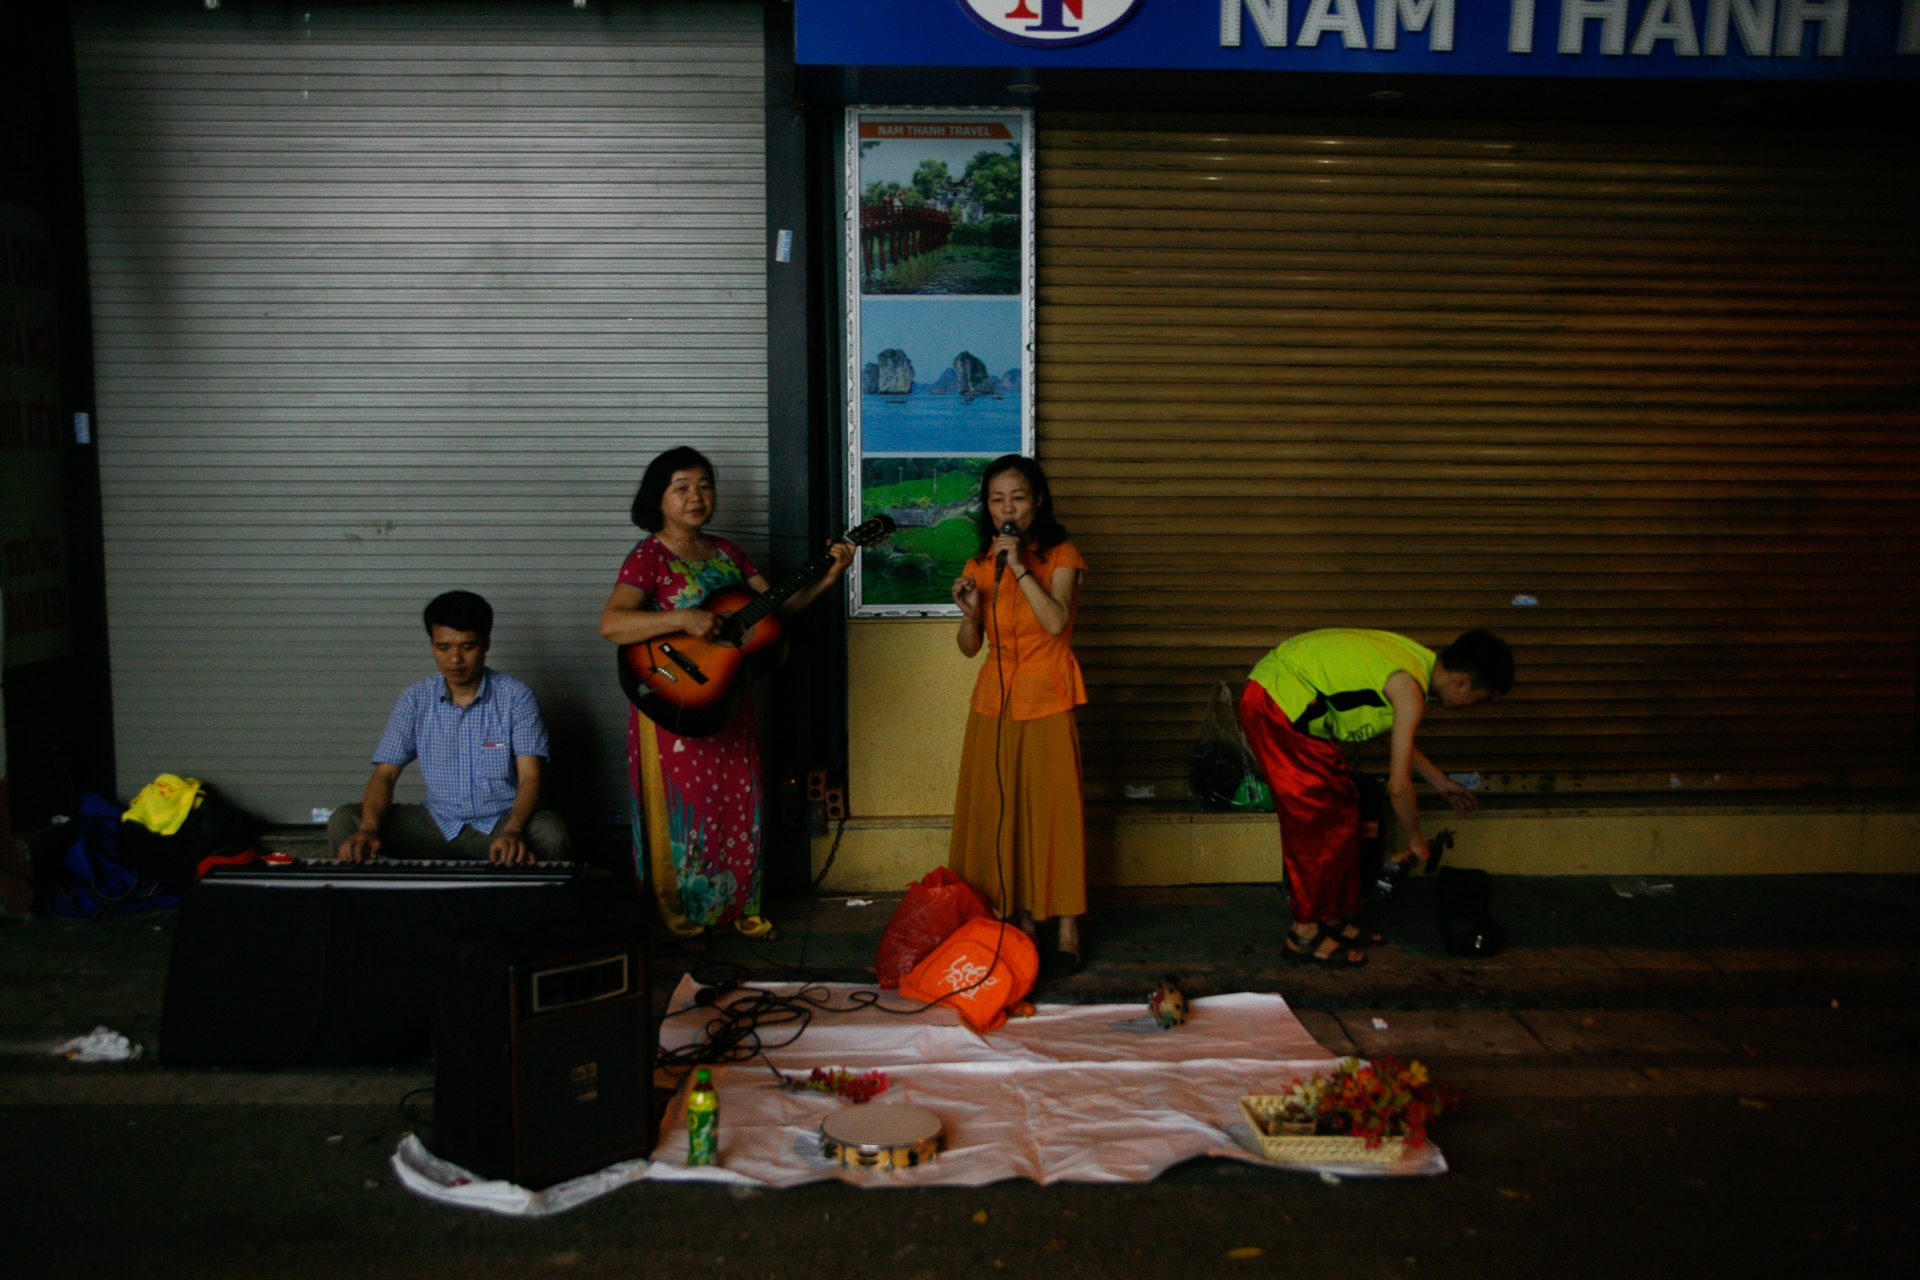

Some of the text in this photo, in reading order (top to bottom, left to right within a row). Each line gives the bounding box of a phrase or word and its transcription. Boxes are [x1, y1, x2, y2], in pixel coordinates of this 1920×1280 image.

[878, 125, 991, 137] NAM THANH TRAVEL
